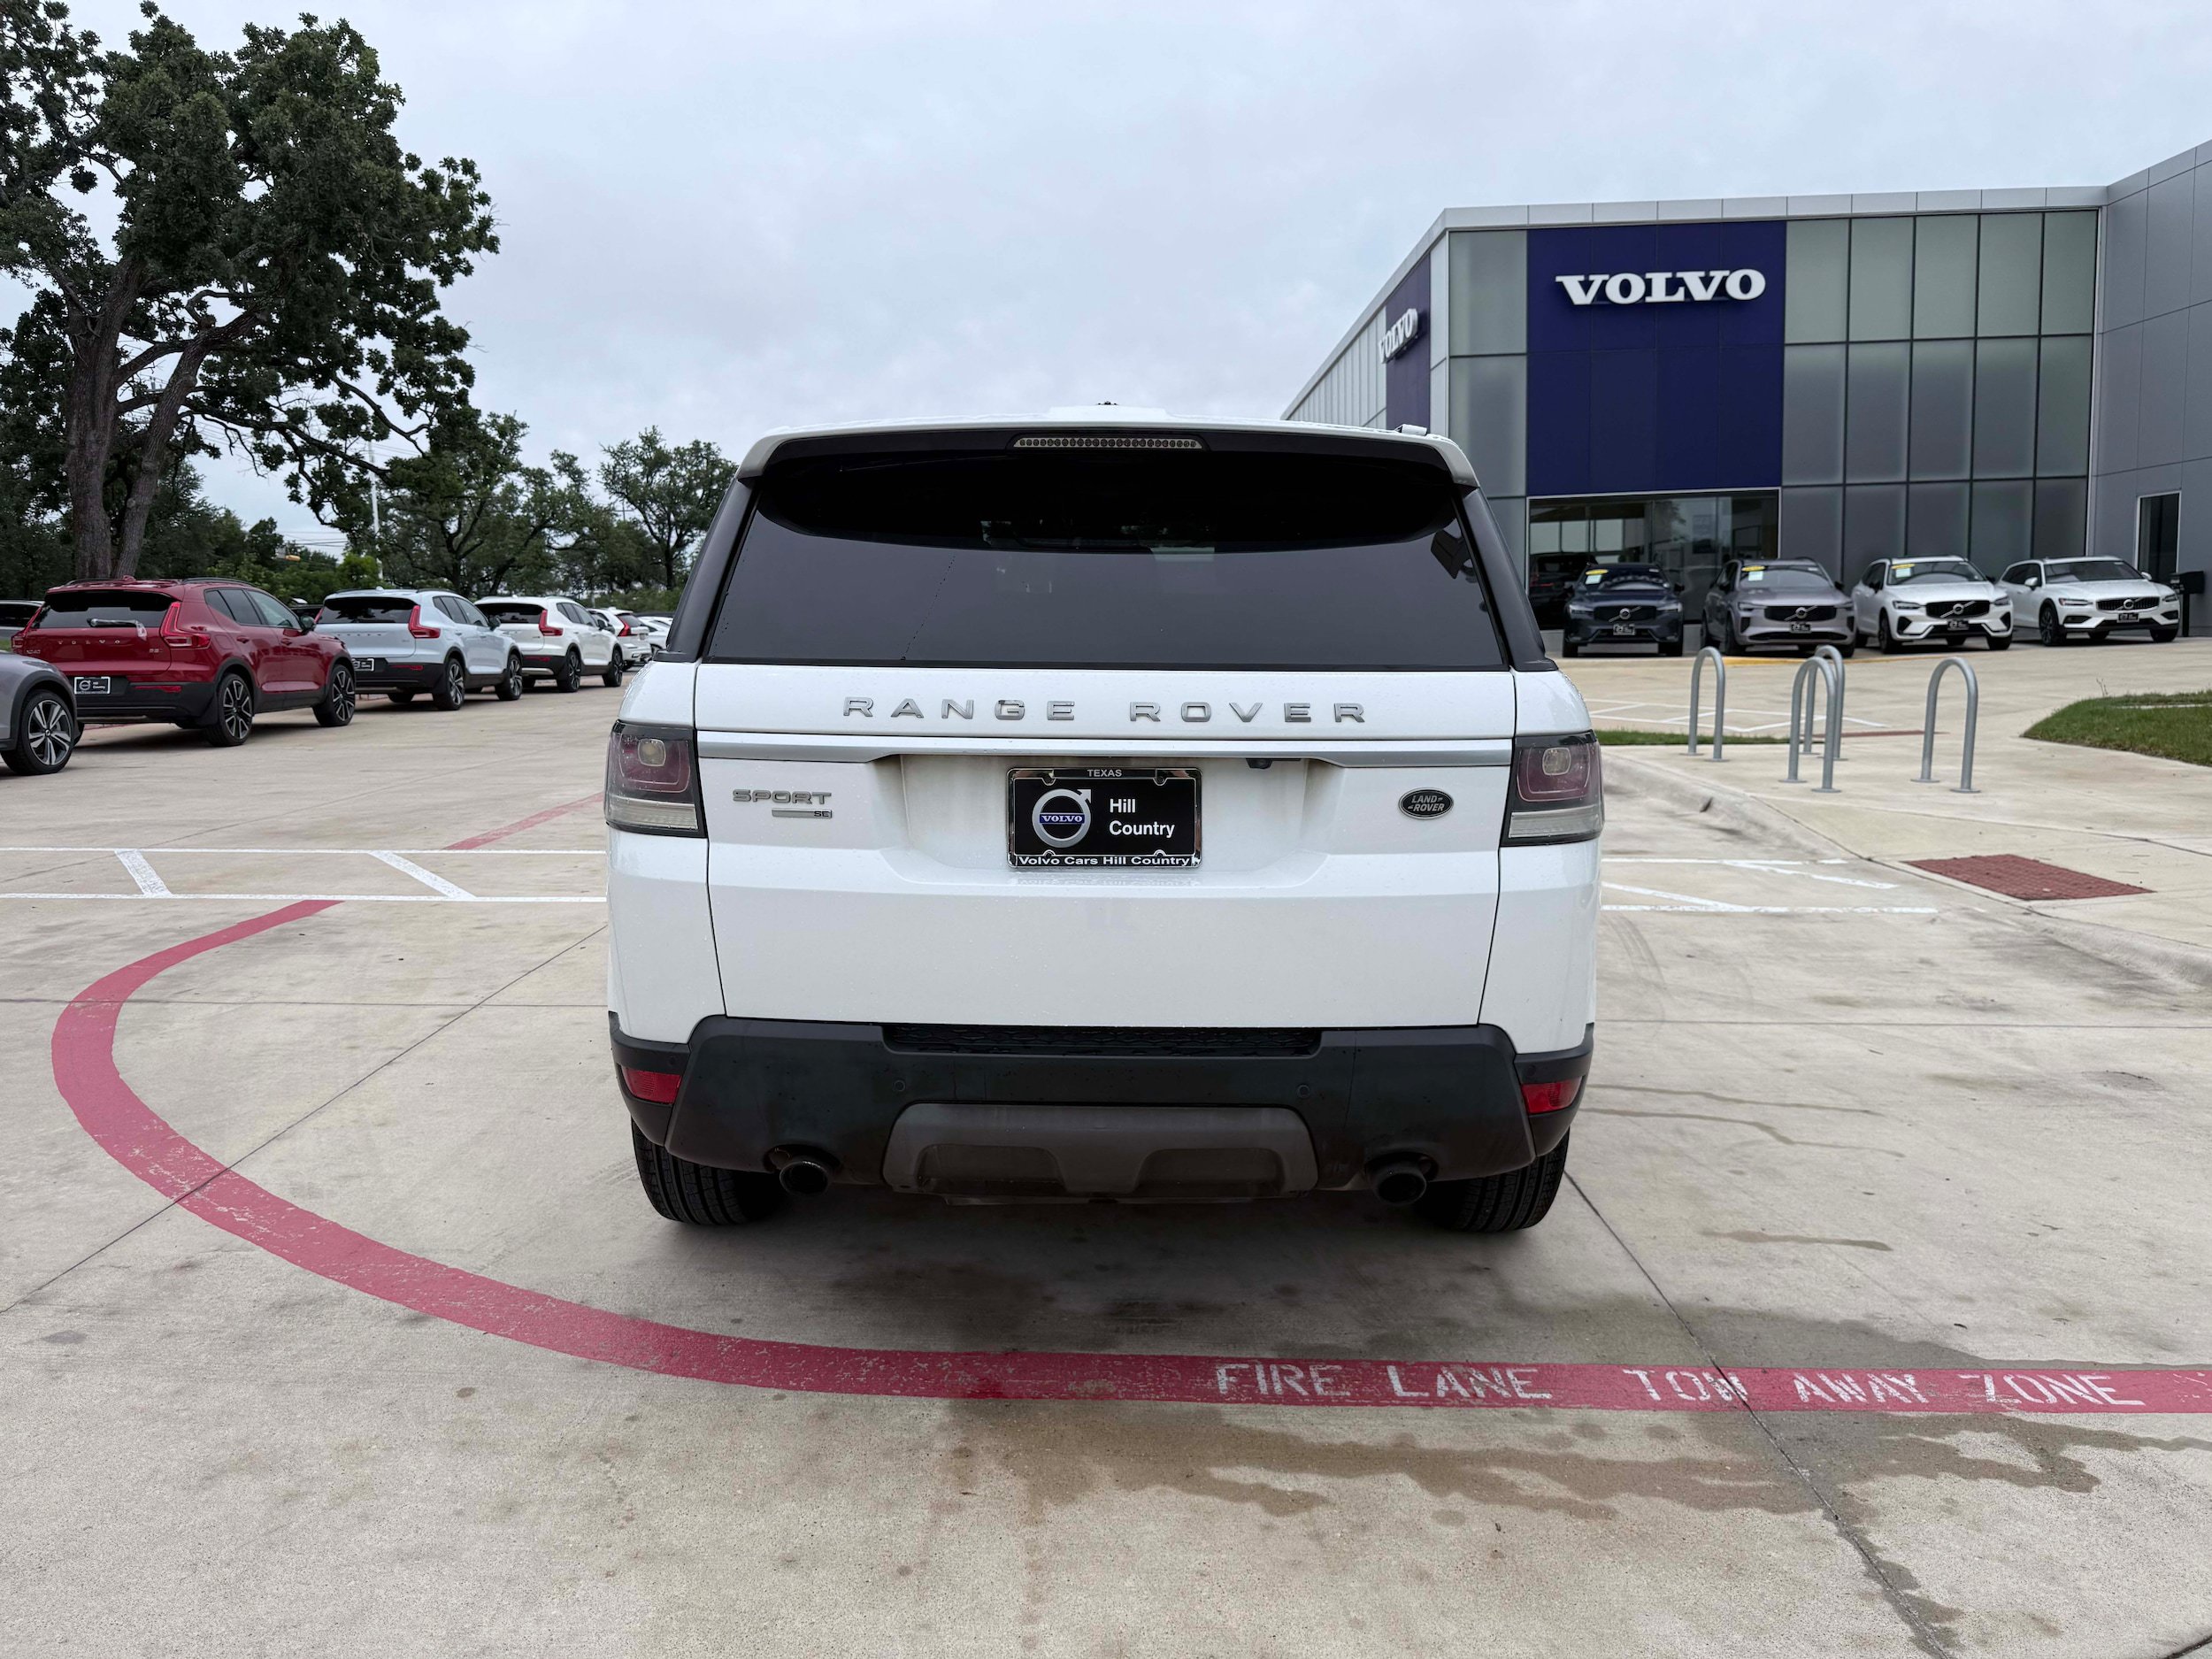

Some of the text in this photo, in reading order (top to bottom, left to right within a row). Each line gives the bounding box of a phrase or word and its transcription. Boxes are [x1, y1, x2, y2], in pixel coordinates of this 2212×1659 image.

[1555, 269, 1766, 305] VOLVO
[1379, 308, 1417, 364] VOLVO
[843, 696, 1365, 724] RANGE ROVER
[1087, 769, 1123, 778] TEXAS
[733, 789, 832, 804] SPORT
[1110, 798, 1136, 813] Hill
[1109, 820, 1175, 838] Country
[1018, 856, 1190, 866] Volvo Cars Hill Country
[1216, 1363, 1350, 1397] FIRE
[1386, 1364, 1552, 1400] LANE
[1623, 1369, 1750, 1404] TOW
[1792, 1372, 1930, 1405] AWAY
[1958, 1373, 2146, 1406] ZONE
